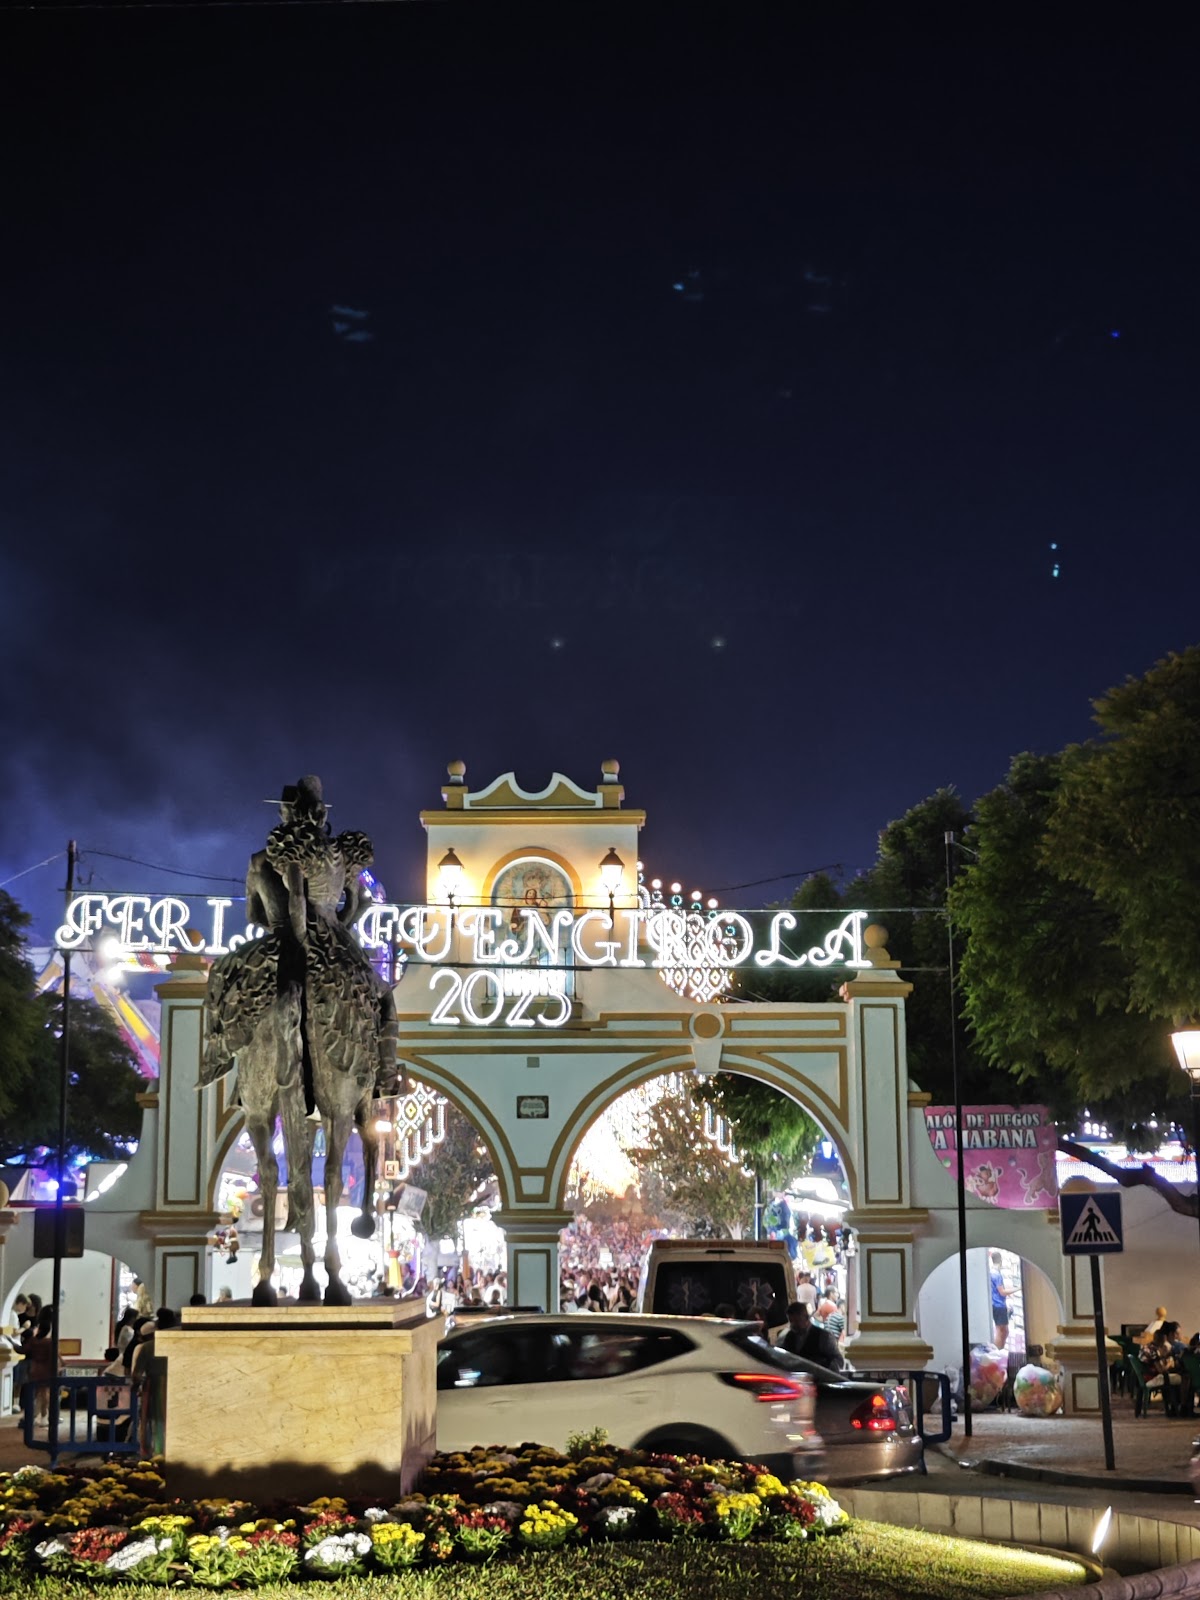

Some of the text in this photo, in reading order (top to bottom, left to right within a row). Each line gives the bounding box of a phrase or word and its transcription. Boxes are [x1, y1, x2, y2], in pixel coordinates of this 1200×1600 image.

[966, 1114, 985, 1128] DE
[990, 1113, 1040, 1128] JUEGOS
[928, 1129, 947, 1149] A
